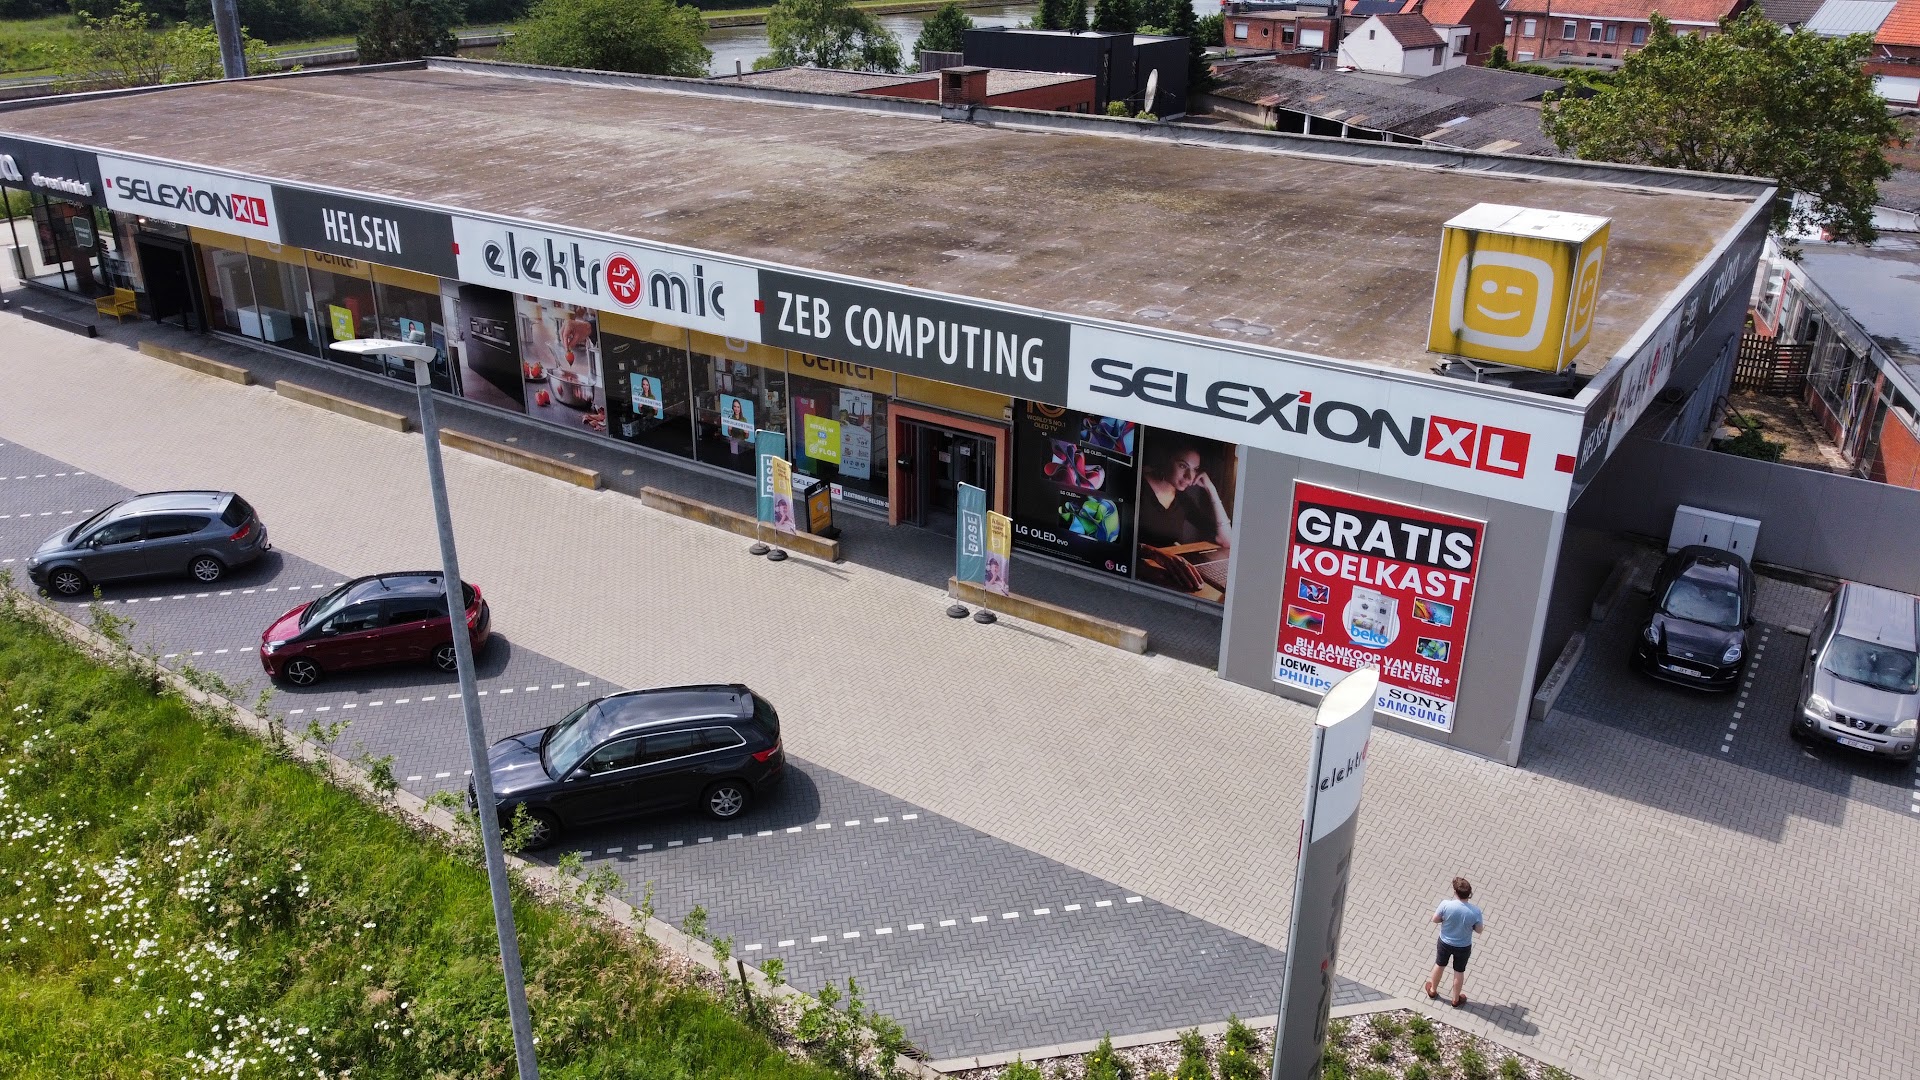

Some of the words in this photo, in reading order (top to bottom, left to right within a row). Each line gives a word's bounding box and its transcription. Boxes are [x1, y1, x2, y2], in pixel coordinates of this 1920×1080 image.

[322, 208, 402, 255] HELSEN
[777, 291, 832, 340] ZEB
[844, 303, 1045, 383] COMPUTING
[1027, 414, 1053, 425] WORLD'S
[1034, 422, 1049, 430] OLED
[967, 516, 979, 553] BASE
[1015, 523, 1028, 536] LG
[1031, 528, 1057, 544] OLED
[1057, 537, 1069, 547] evo
[1297, 507, 1474, 570] GRATIS
[1116, 563, 1128, 574] LG
[1291, 545, 1471, 601] KOELKAST
[1350, 624, 1388, 645] beko
[1296, 636, 1315, 649] BIJ
[1317, 641, 1382, 664] AANKOOP
[1384, 655, 1413, 671] VAN
[1415, 663, 1440, 677] EEN
[1279, 667, 1332, 691] PHILIPS
[1377, 697, 1446, 725] SAMSUNG
[1388, 688, 1448, 712] SONY
